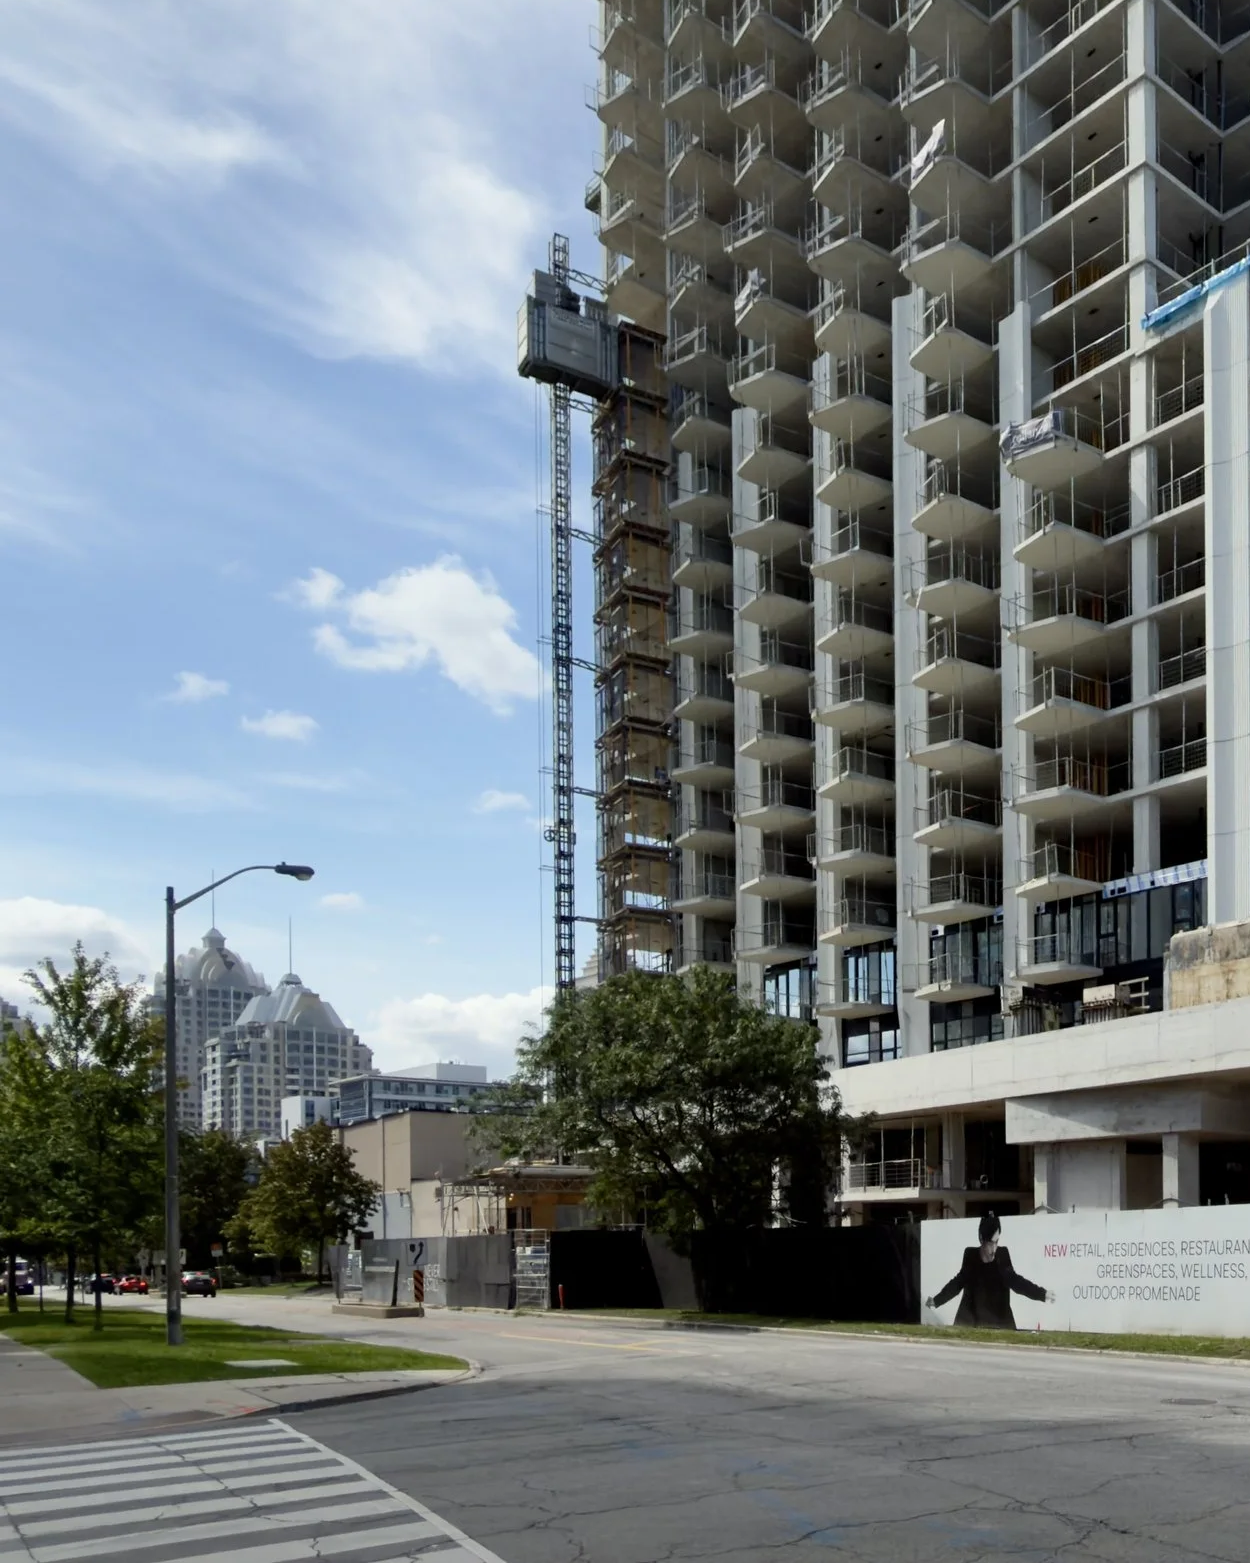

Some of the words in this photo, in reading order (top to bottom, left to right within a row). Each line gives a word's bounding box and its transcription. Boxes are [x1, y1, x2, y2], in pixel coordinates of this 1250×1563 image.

[1043, 1244, 1068, 1258] NEW
[1069, 1242, 1106, 1259] RETAIL,
[1107, 1240, 1179, 1258] RESIDENCES,
[1096, 1263, 1179, 1280] GREENSPACES,
[1180, 1262, 1249, 1281] WELLNESS,
[1072, 1284, 1126, 1300] OUTDOOR
[1128, 1285, 1201, 1302] PROMENADE
